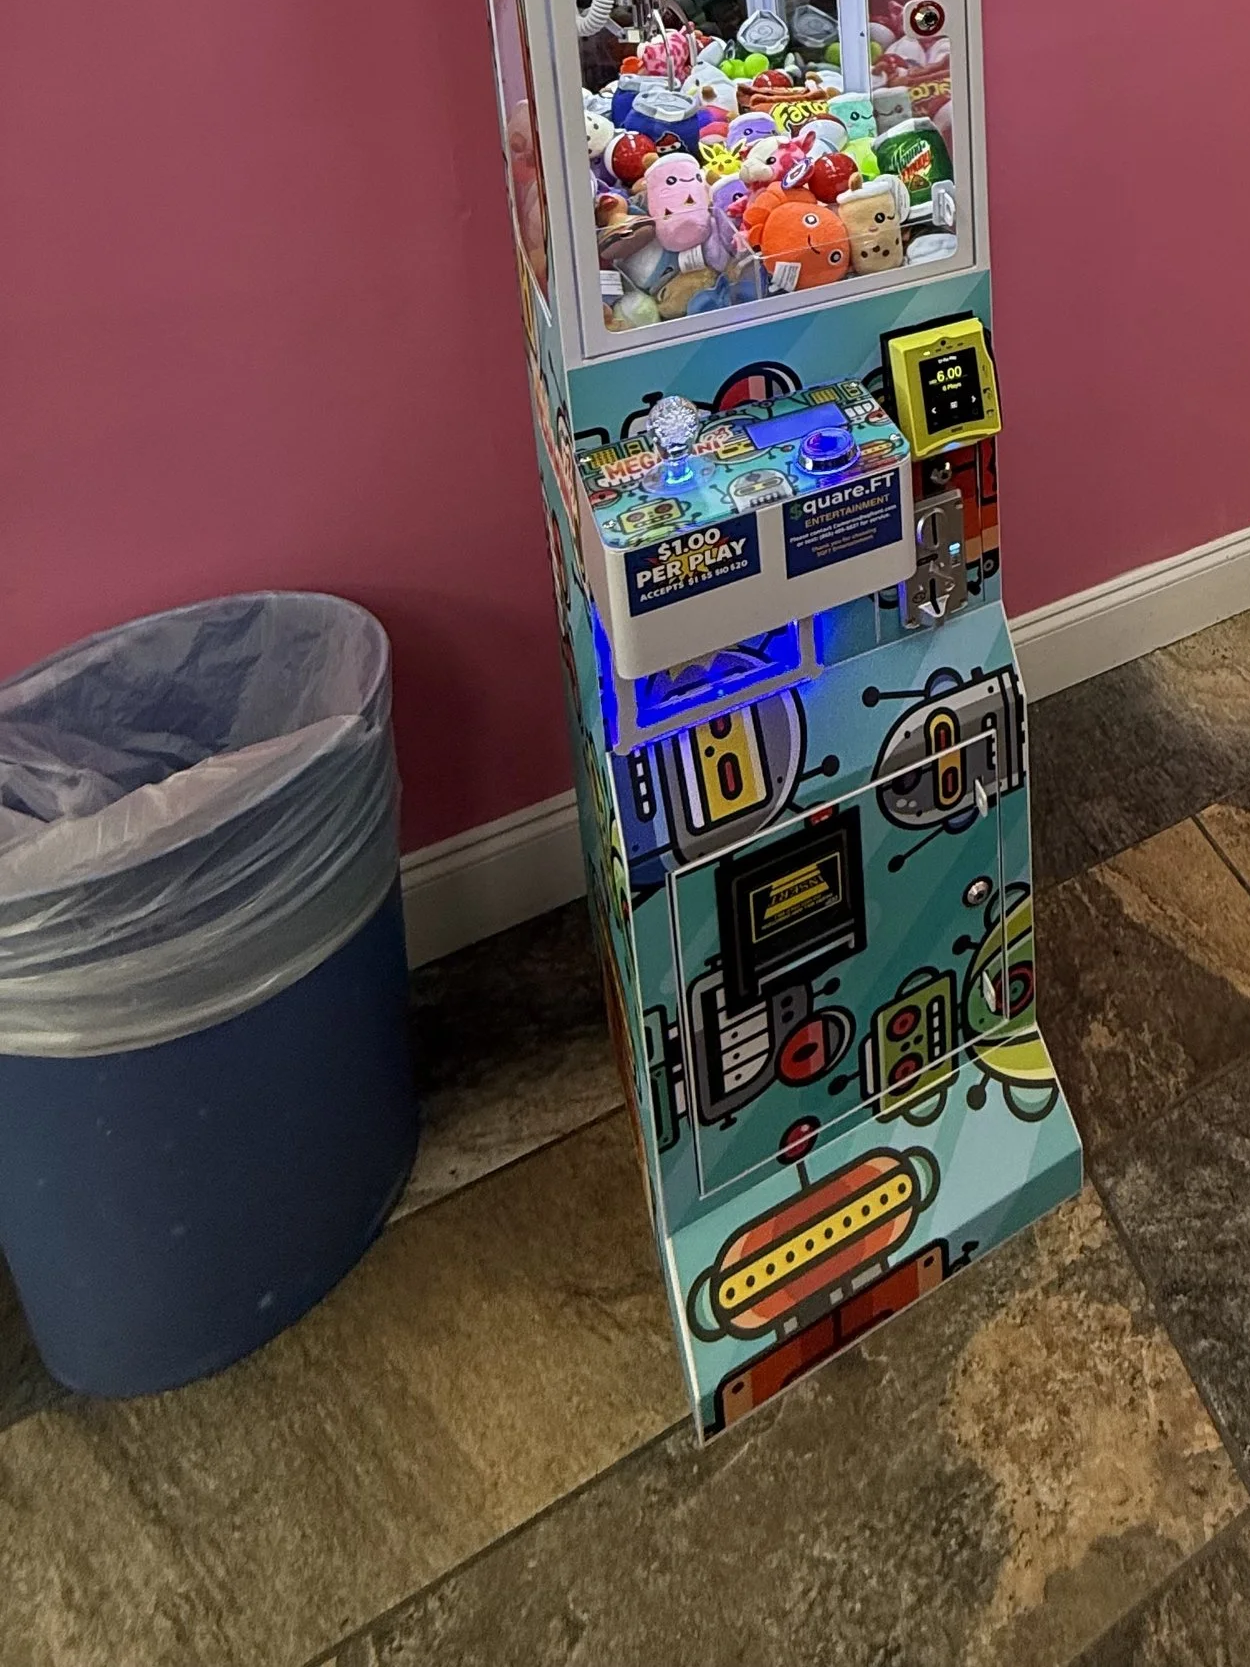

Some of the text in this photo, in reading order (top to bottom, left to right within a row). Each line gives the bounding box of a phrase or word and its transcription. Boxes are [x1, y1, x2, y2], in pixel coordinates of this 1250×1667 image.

[936, 366, 962, 383] 6.00
[805, 494, 891, 528] ENTERTAINMENT
[658, 528, 720, 561] $1.00
[636, 538, 746, 589] PER PLAY
[640, 560, 748, 602] ACCEPTS $1 $5 $10 $20
